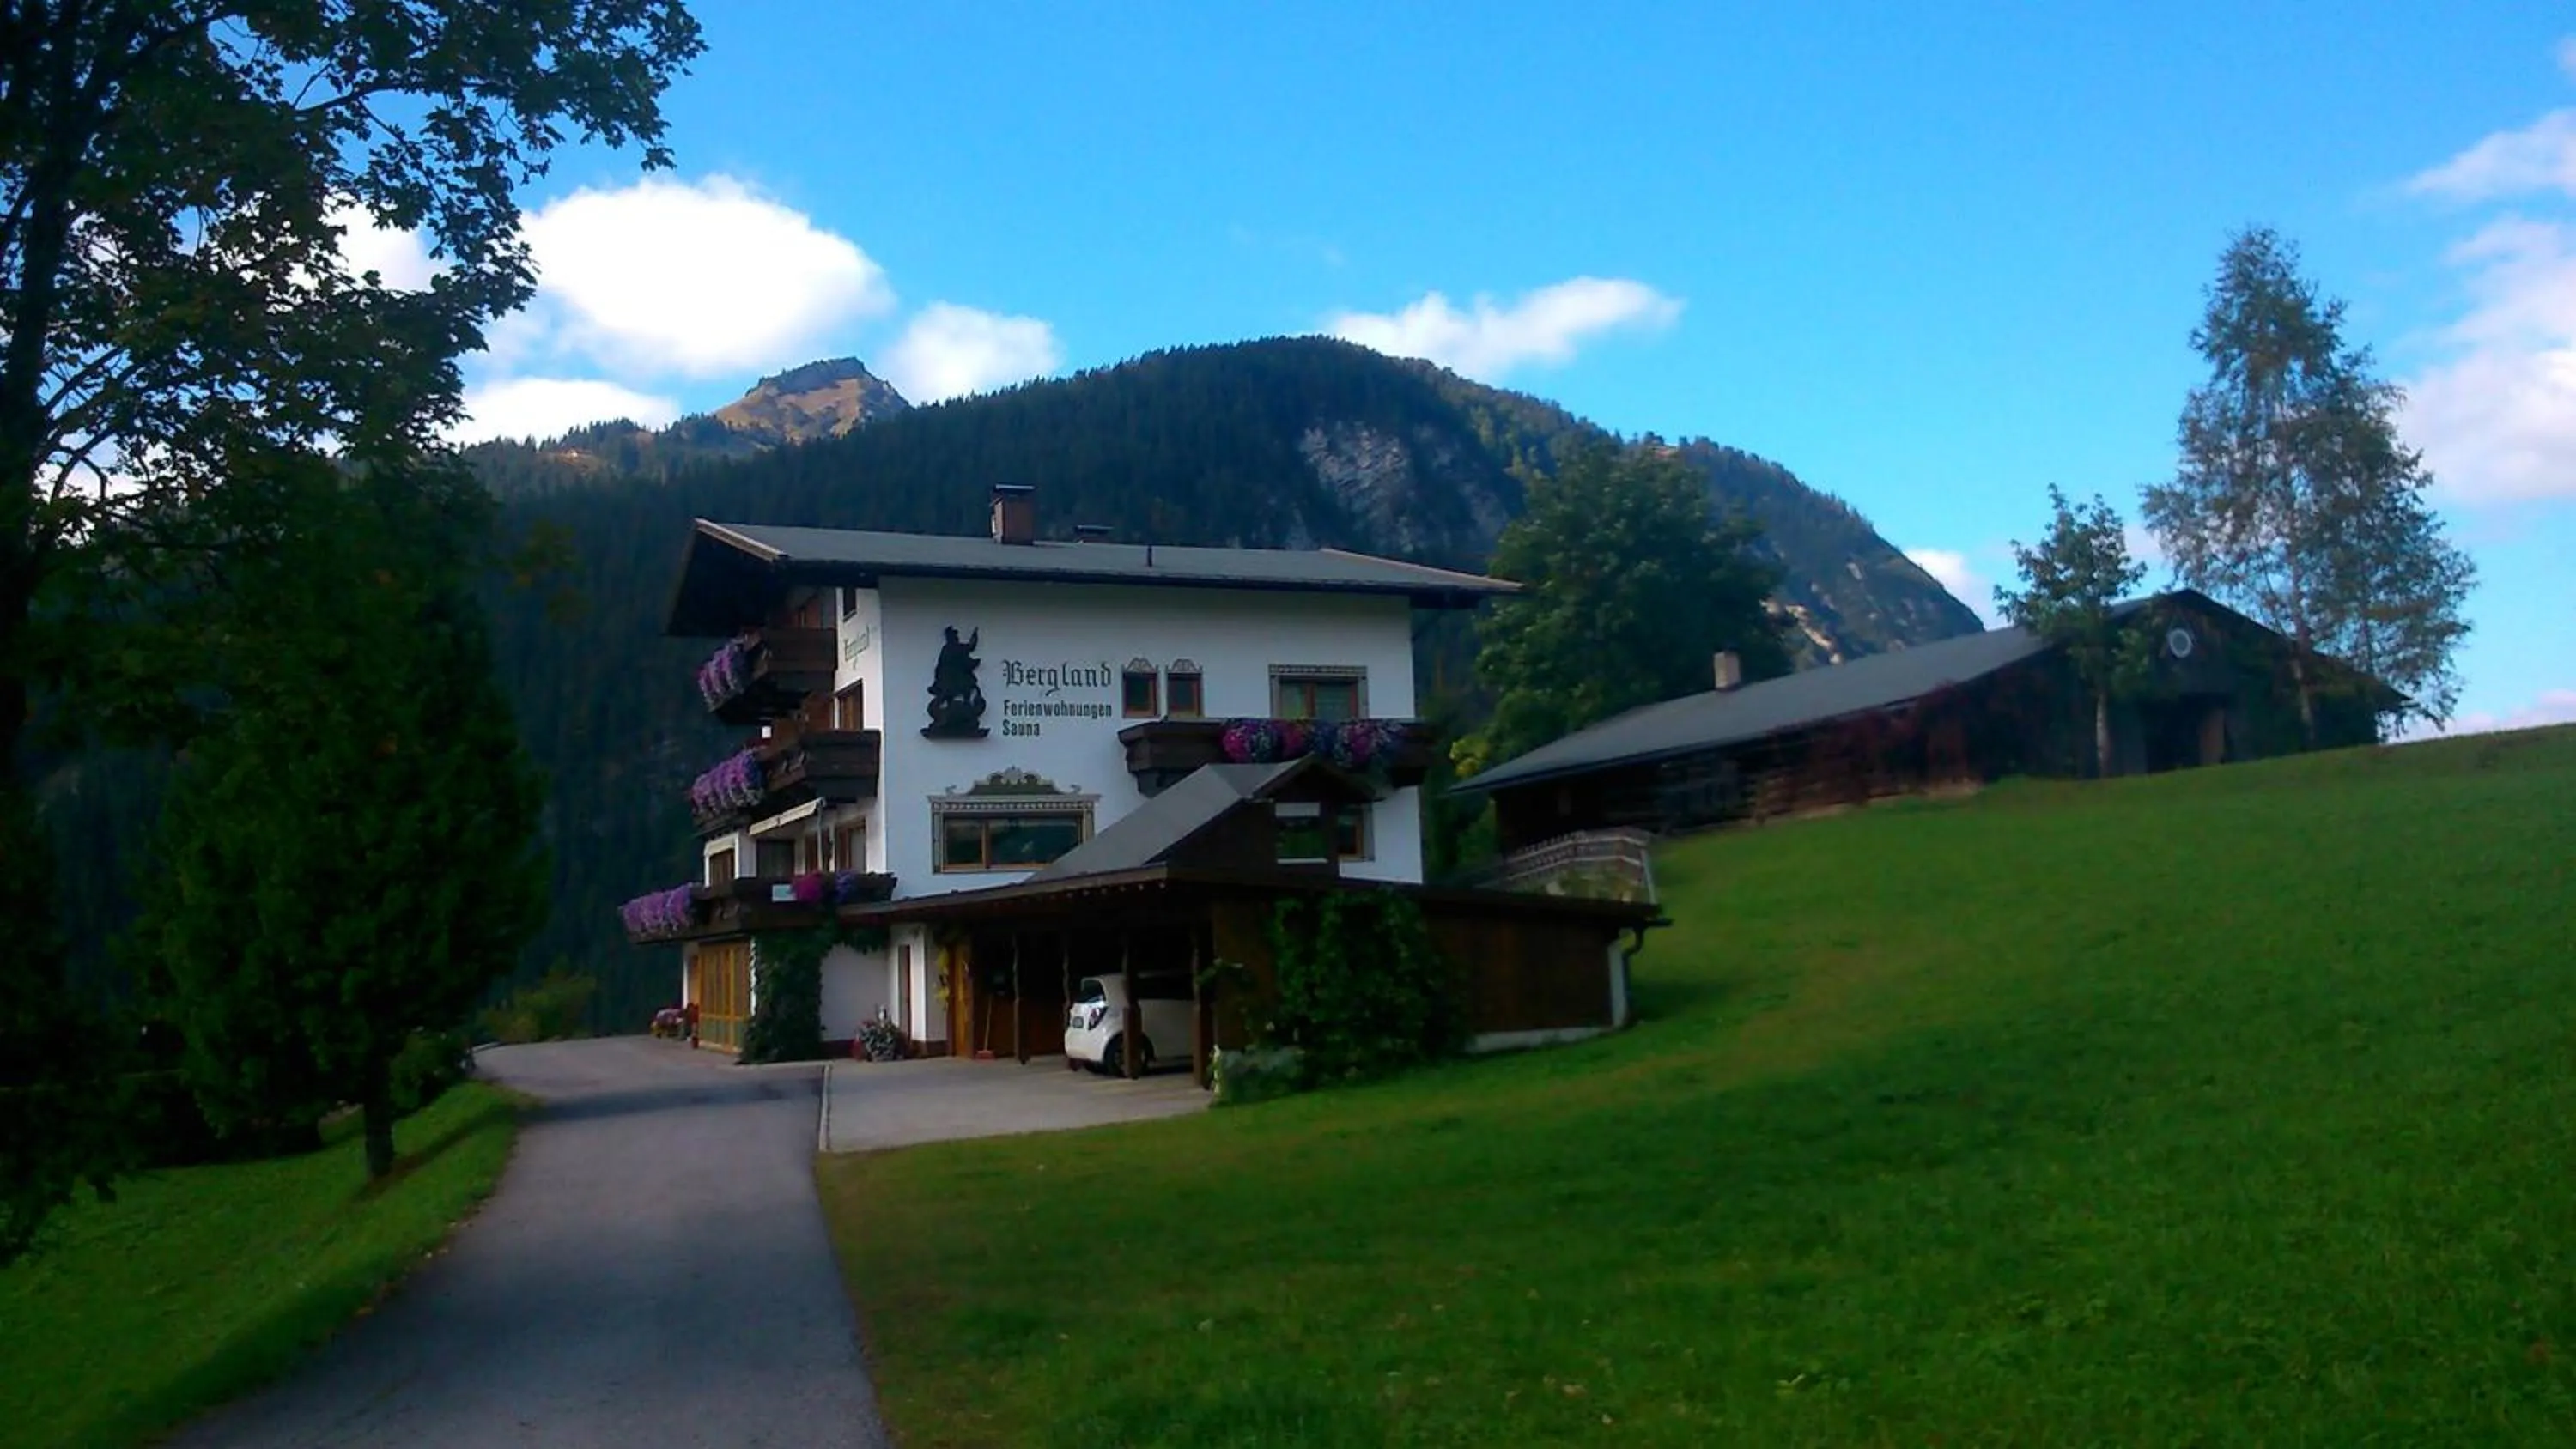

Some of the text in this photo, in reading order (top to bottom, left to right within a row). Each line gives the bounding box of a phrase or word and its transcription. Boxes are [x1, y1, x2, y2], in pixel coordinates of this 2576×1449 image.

[1002, 658, 1112, 696] Bergland
[1003, 700, 1113, 719] Ferienwohnungen
[1002, 718, 1041, 737] Sauna
